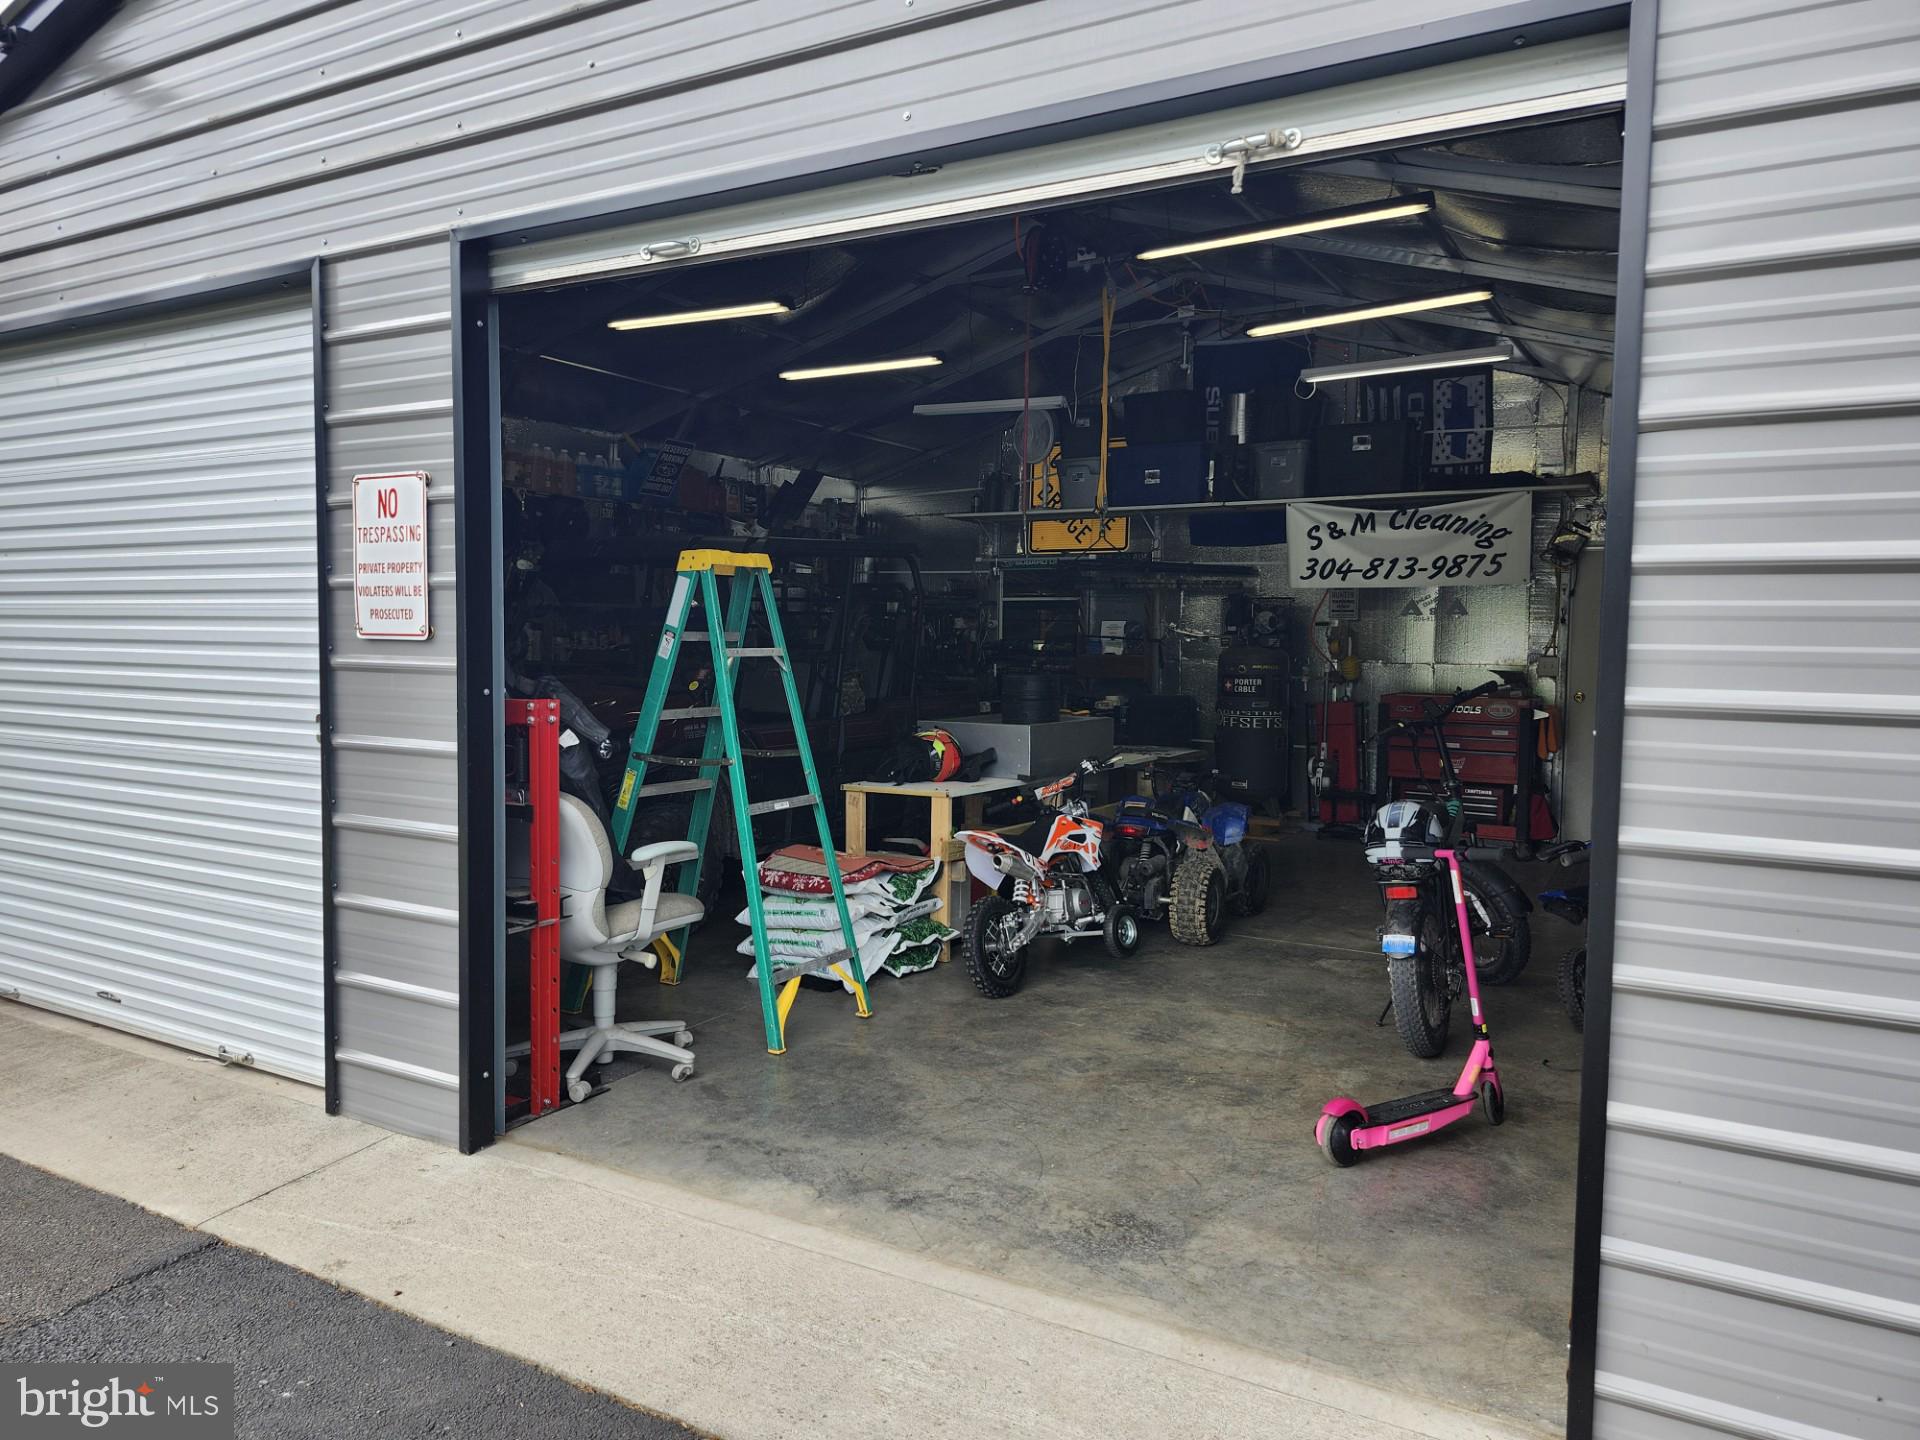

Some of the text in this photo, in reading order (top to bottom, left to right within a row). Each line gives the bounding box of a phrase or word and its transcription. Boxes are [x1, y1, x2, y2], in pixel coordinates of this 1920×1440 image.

[377, 487, 398, 519] NO
[357, 525, 422, 544] TRESPASSING
[1388, 508, 1512, 549] Cleaning
[358, 562, 423, 574] PRIVATE PROPERTY
[1300, 552, 1507, 581] 304-813-9875
[358, 586, 422, 597] VIOLATERS WILL BE
[370, 609, 413, 620] PROSECUTED
[1234, 678, 1263, 686] PORTER
